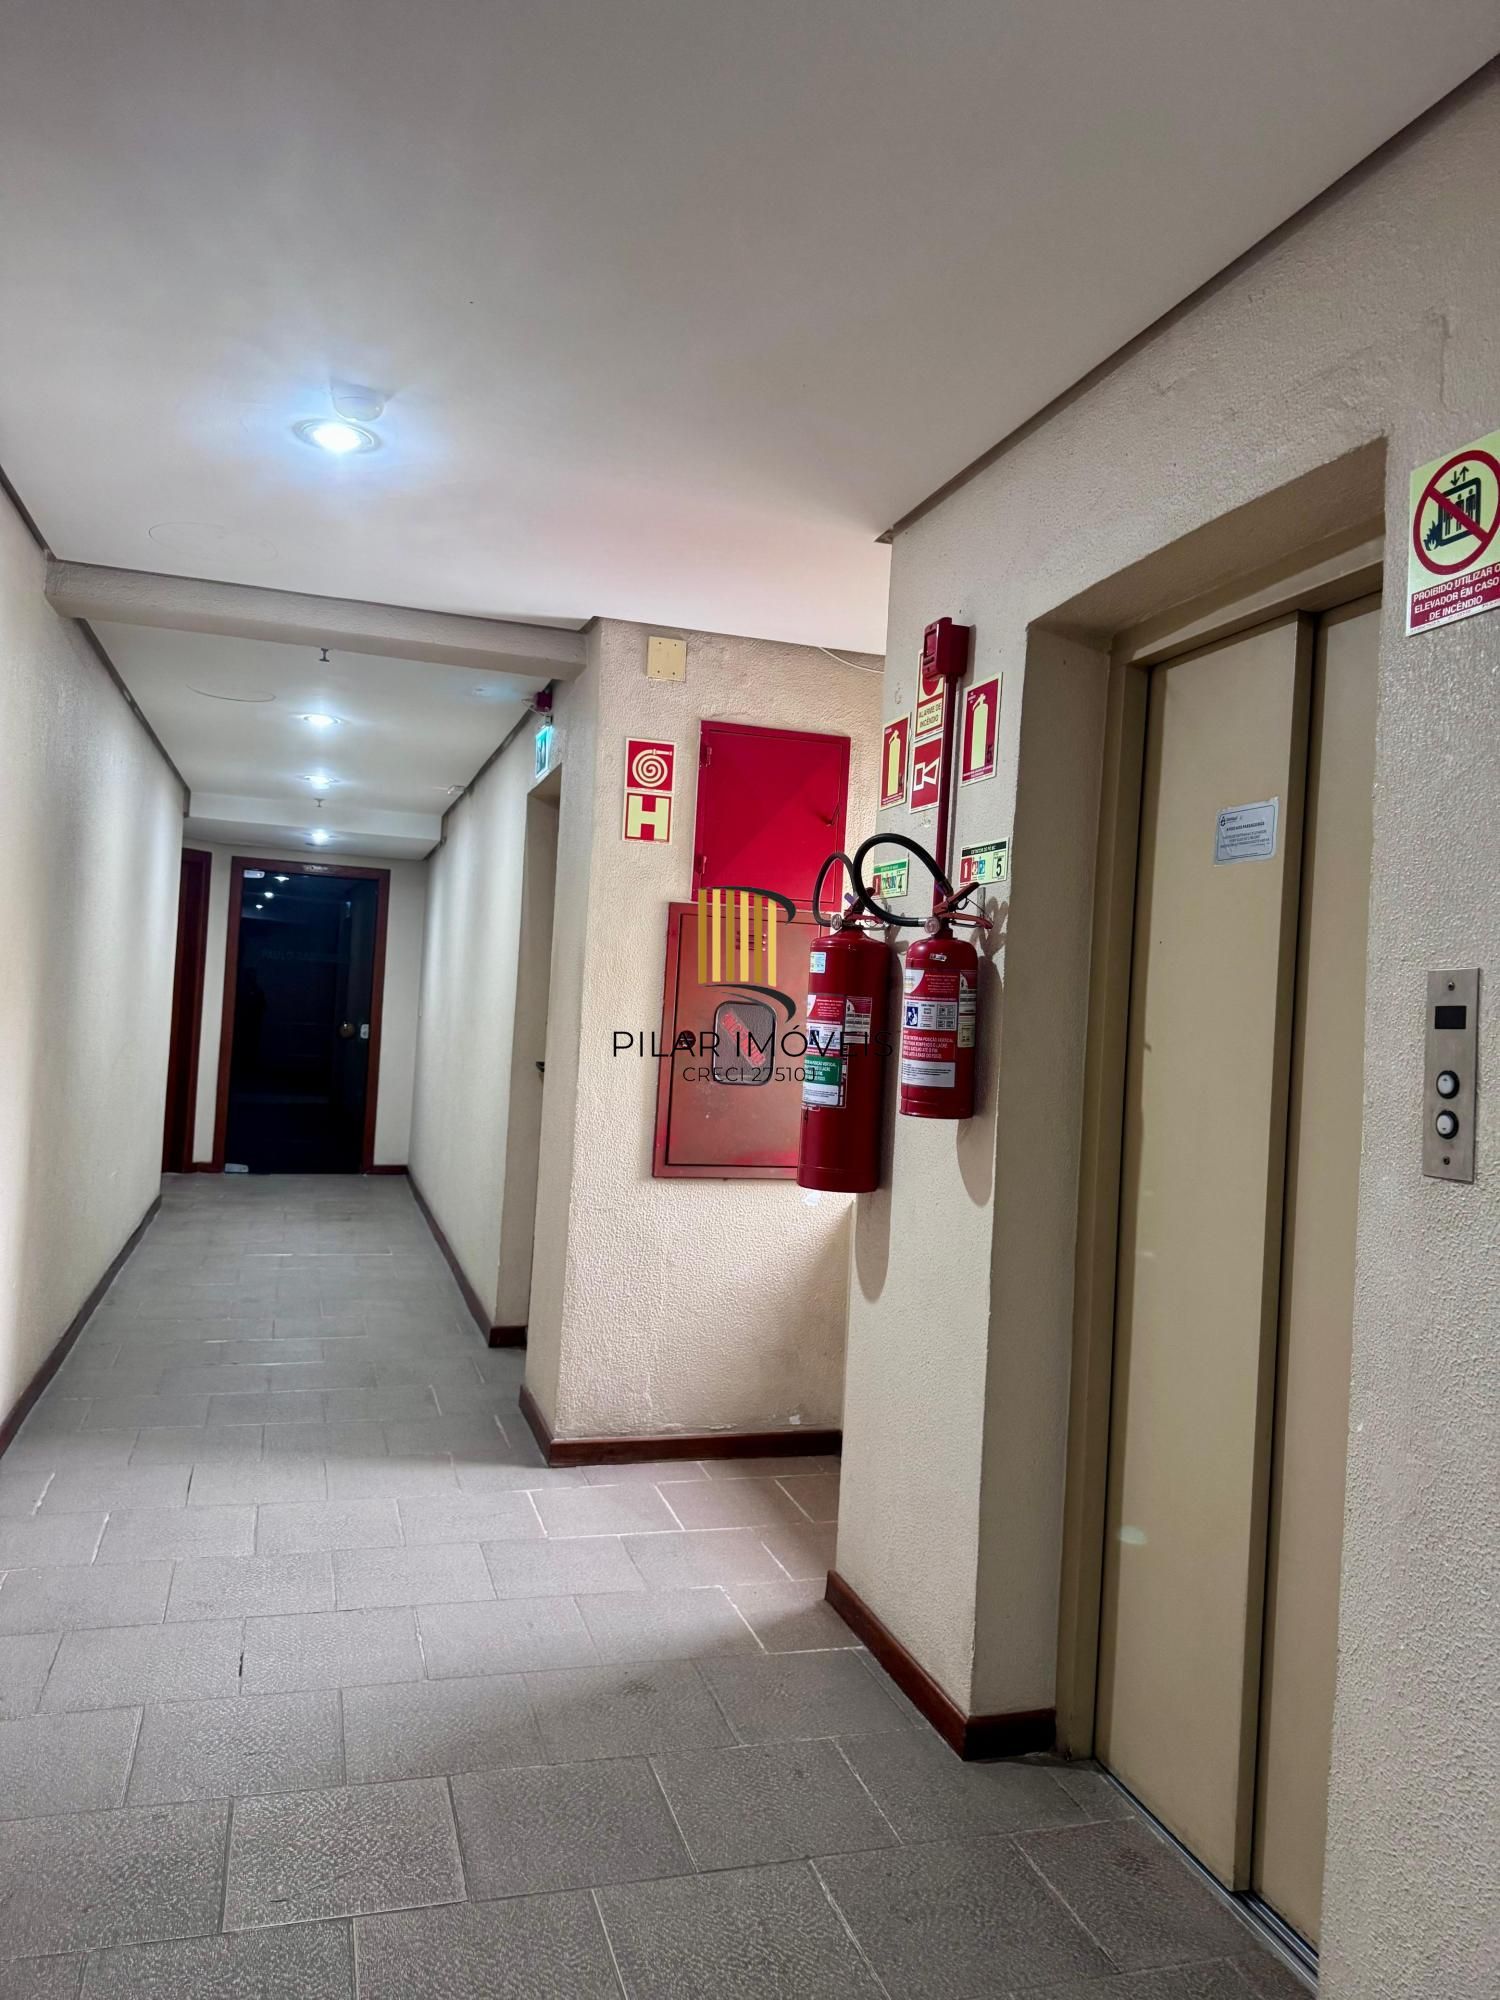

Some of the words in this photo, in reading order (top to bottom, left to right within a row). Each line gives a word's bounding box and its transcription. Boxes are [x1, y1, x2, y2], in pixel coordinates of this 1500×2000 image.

[1413, 582, 1454, 602] PROIBIDO
[1454, 566, 1492, 588] UTILIZAR
[1415, 591, 1459, 614] ELEVADOR
[1474, 576, 1500, 593] CASO
[1429, 609, 1441, 621] DE
[1442, 595, 1483, 617] INCÊNDIO
